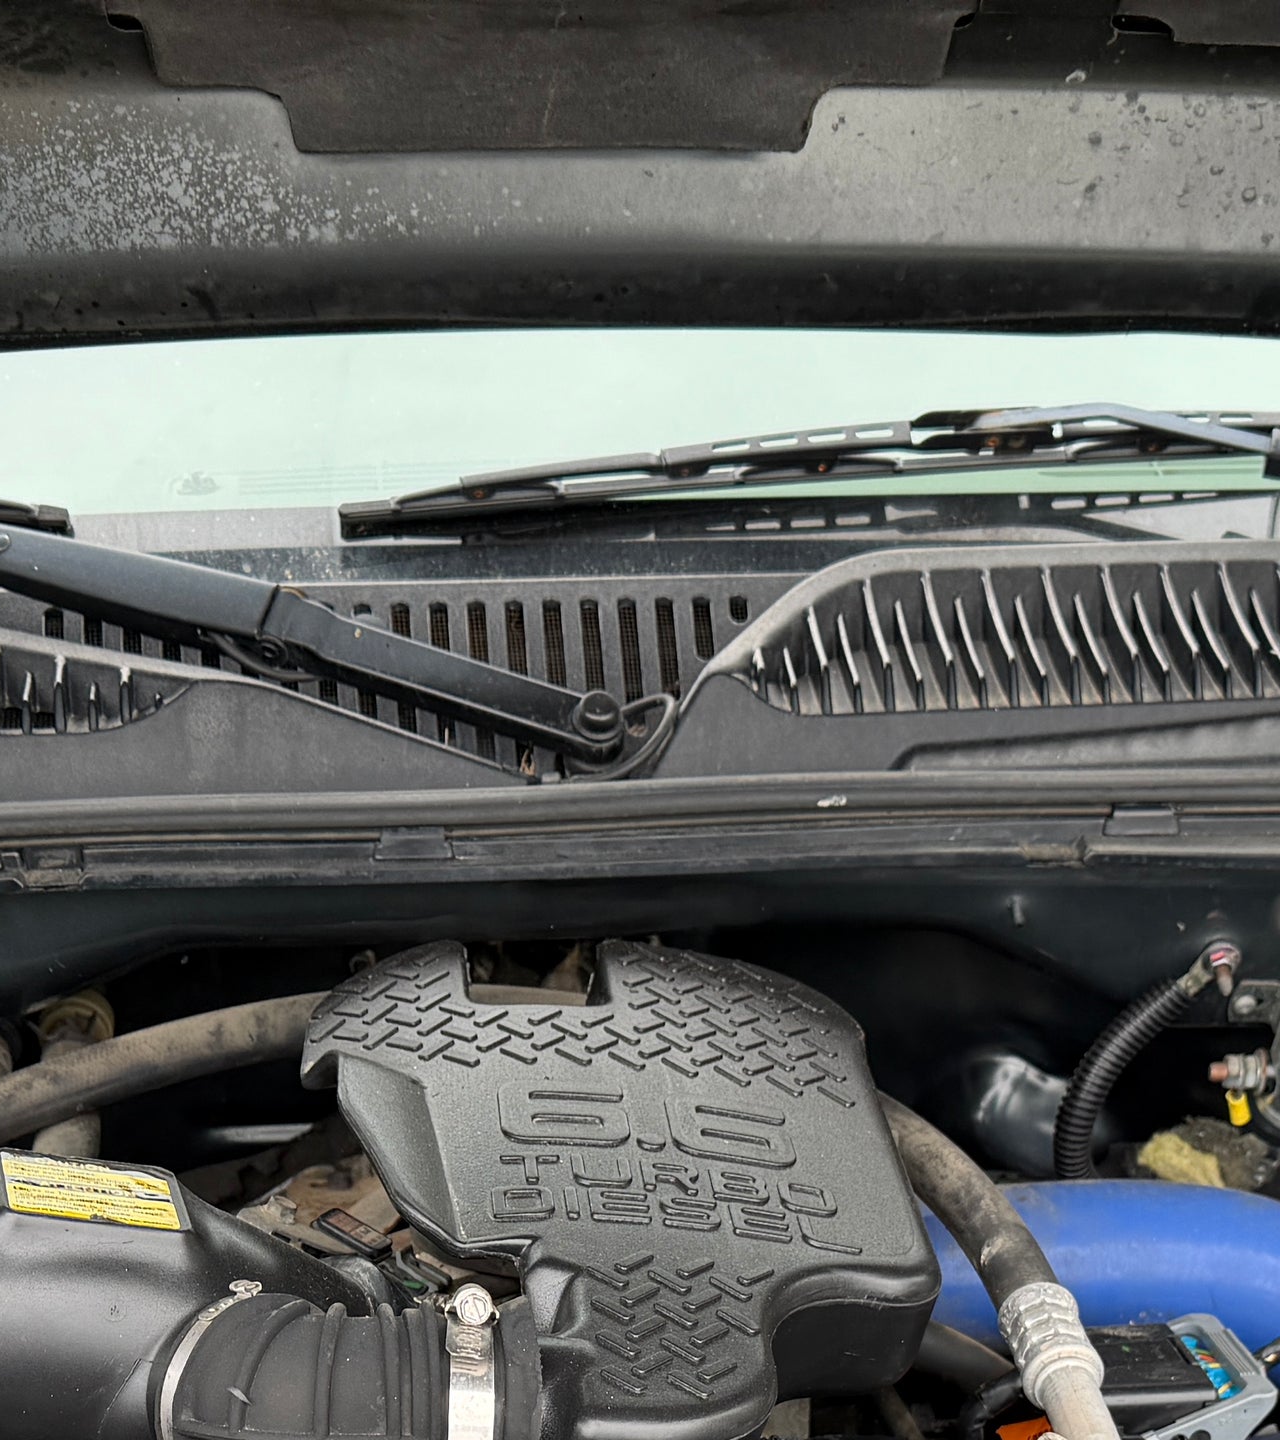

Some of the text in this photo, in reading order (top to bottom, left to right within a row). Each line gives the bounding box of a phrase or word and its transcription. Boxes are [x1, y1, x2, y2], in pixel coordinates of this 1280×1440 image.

[497, 1078, 797, 1168] 6.6
[491, 1185, 863, 1255] DIESEL
[499, 1154, 838, 1218] TURBO
